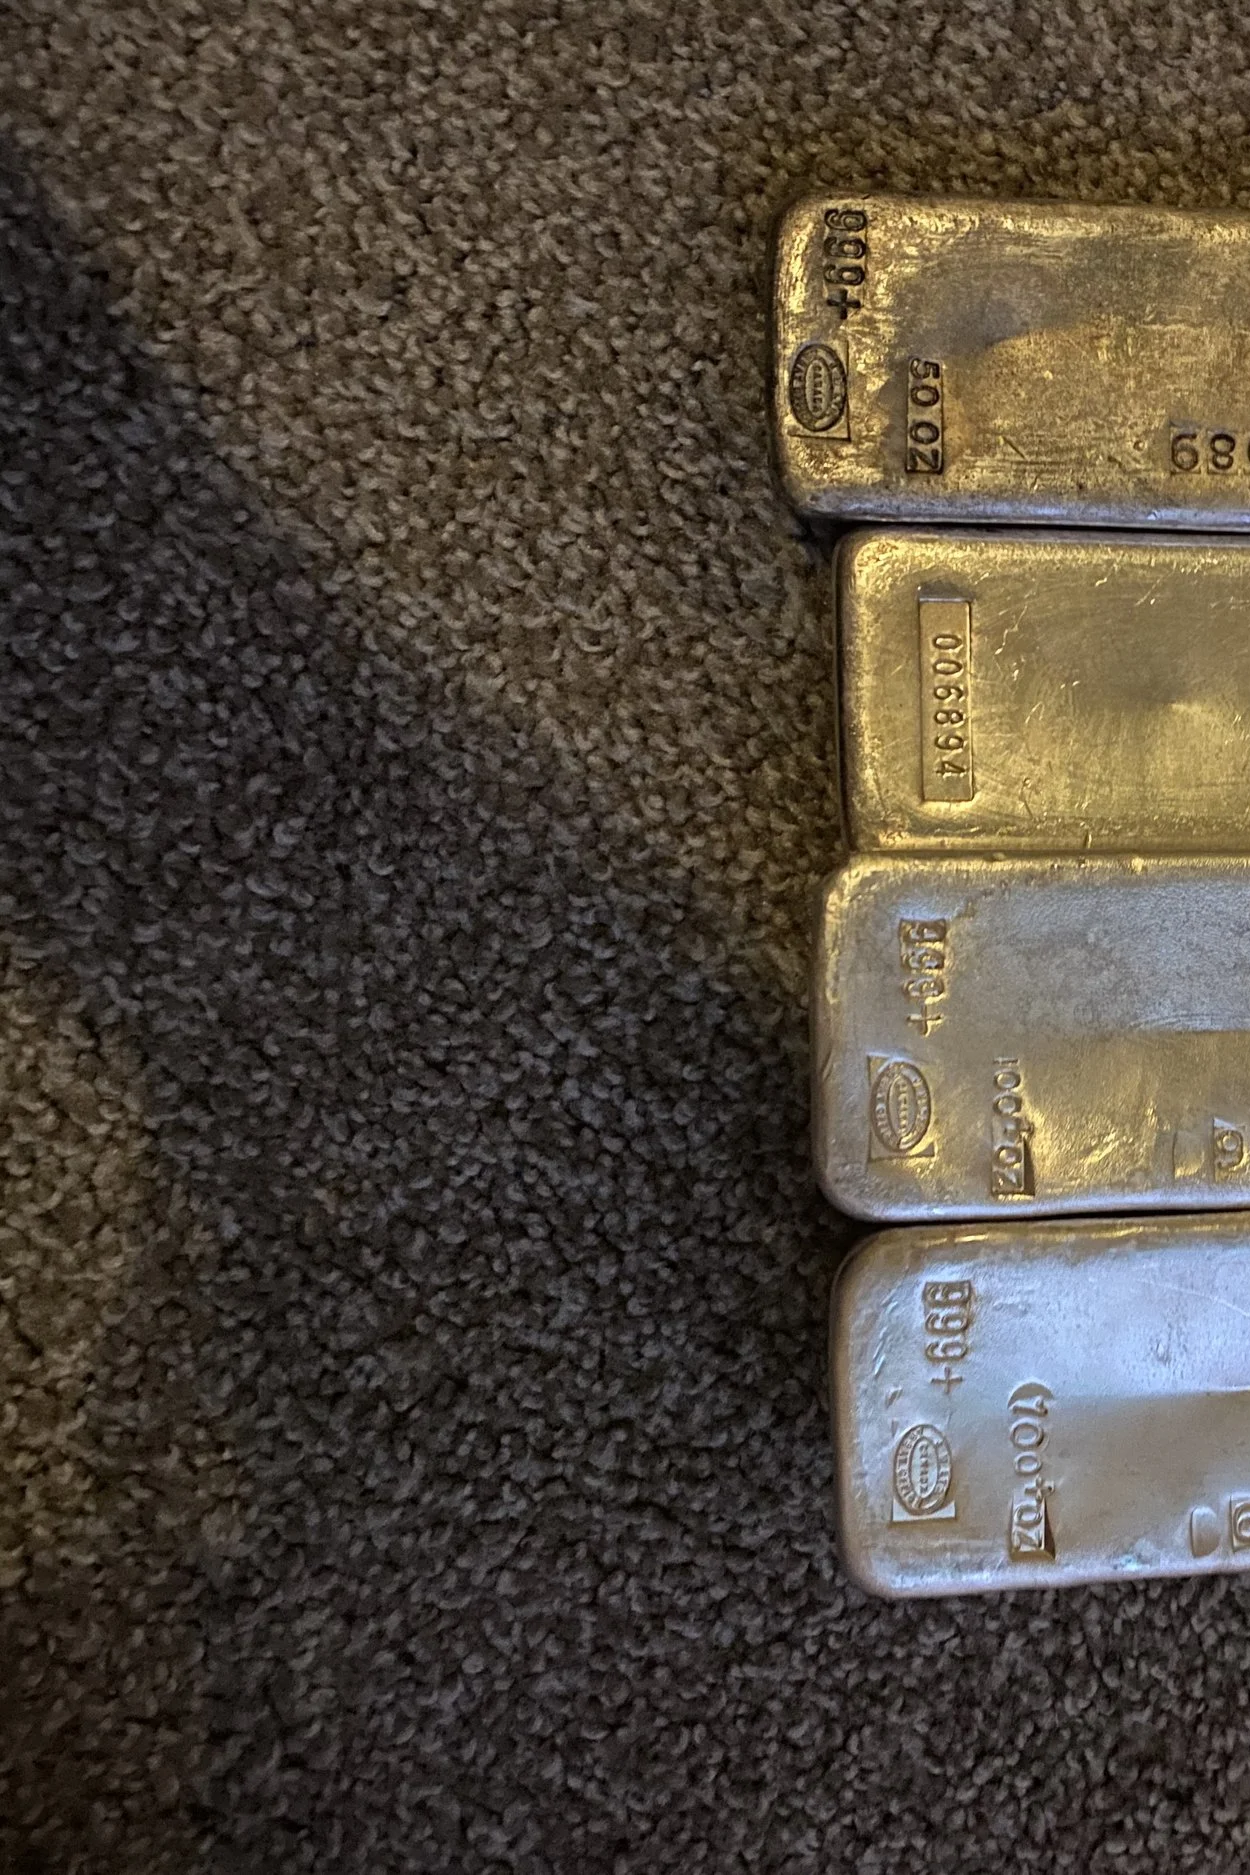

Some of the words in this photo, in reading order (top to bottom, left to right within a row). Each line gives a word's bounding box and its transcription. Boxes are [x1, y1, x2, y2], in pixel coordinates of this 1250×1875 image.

[823, 208, 868, 320] 999+
[908, 356, 942, 409] 50
[908, 420, 942, 474] OZ
[932, 633, 967, 778] 006894
[922, 1280, 970, 1394] 999+
